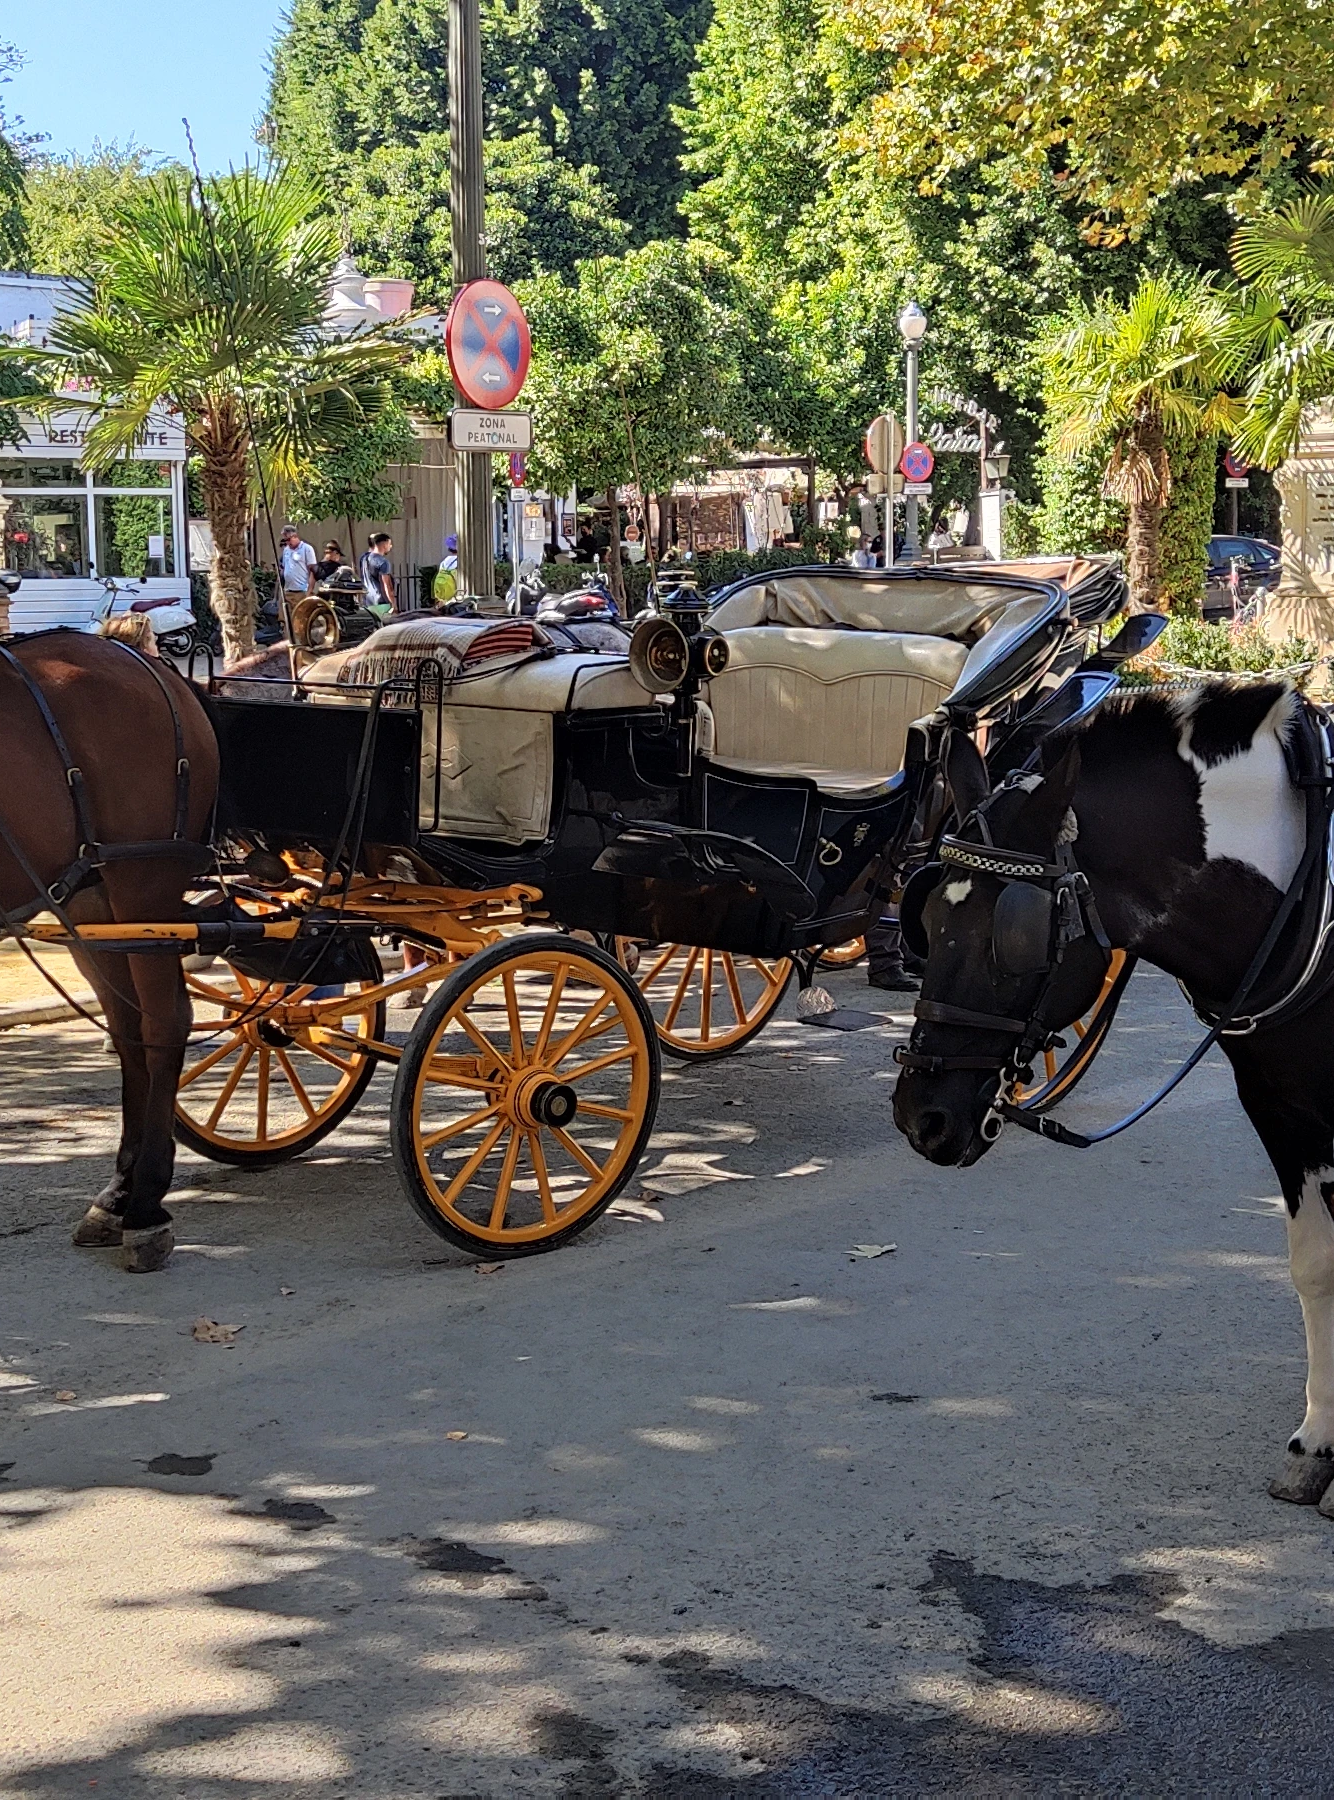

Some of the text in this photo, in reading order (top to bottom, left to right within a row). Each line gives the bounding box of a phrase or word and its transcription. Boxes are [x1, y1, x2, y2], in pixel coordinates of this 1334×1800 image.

[479, 417, 506, 429] ZONA
[49, 429, 167, 446] RESTNTE
[467, 431, 518, 445] PEATONAL
